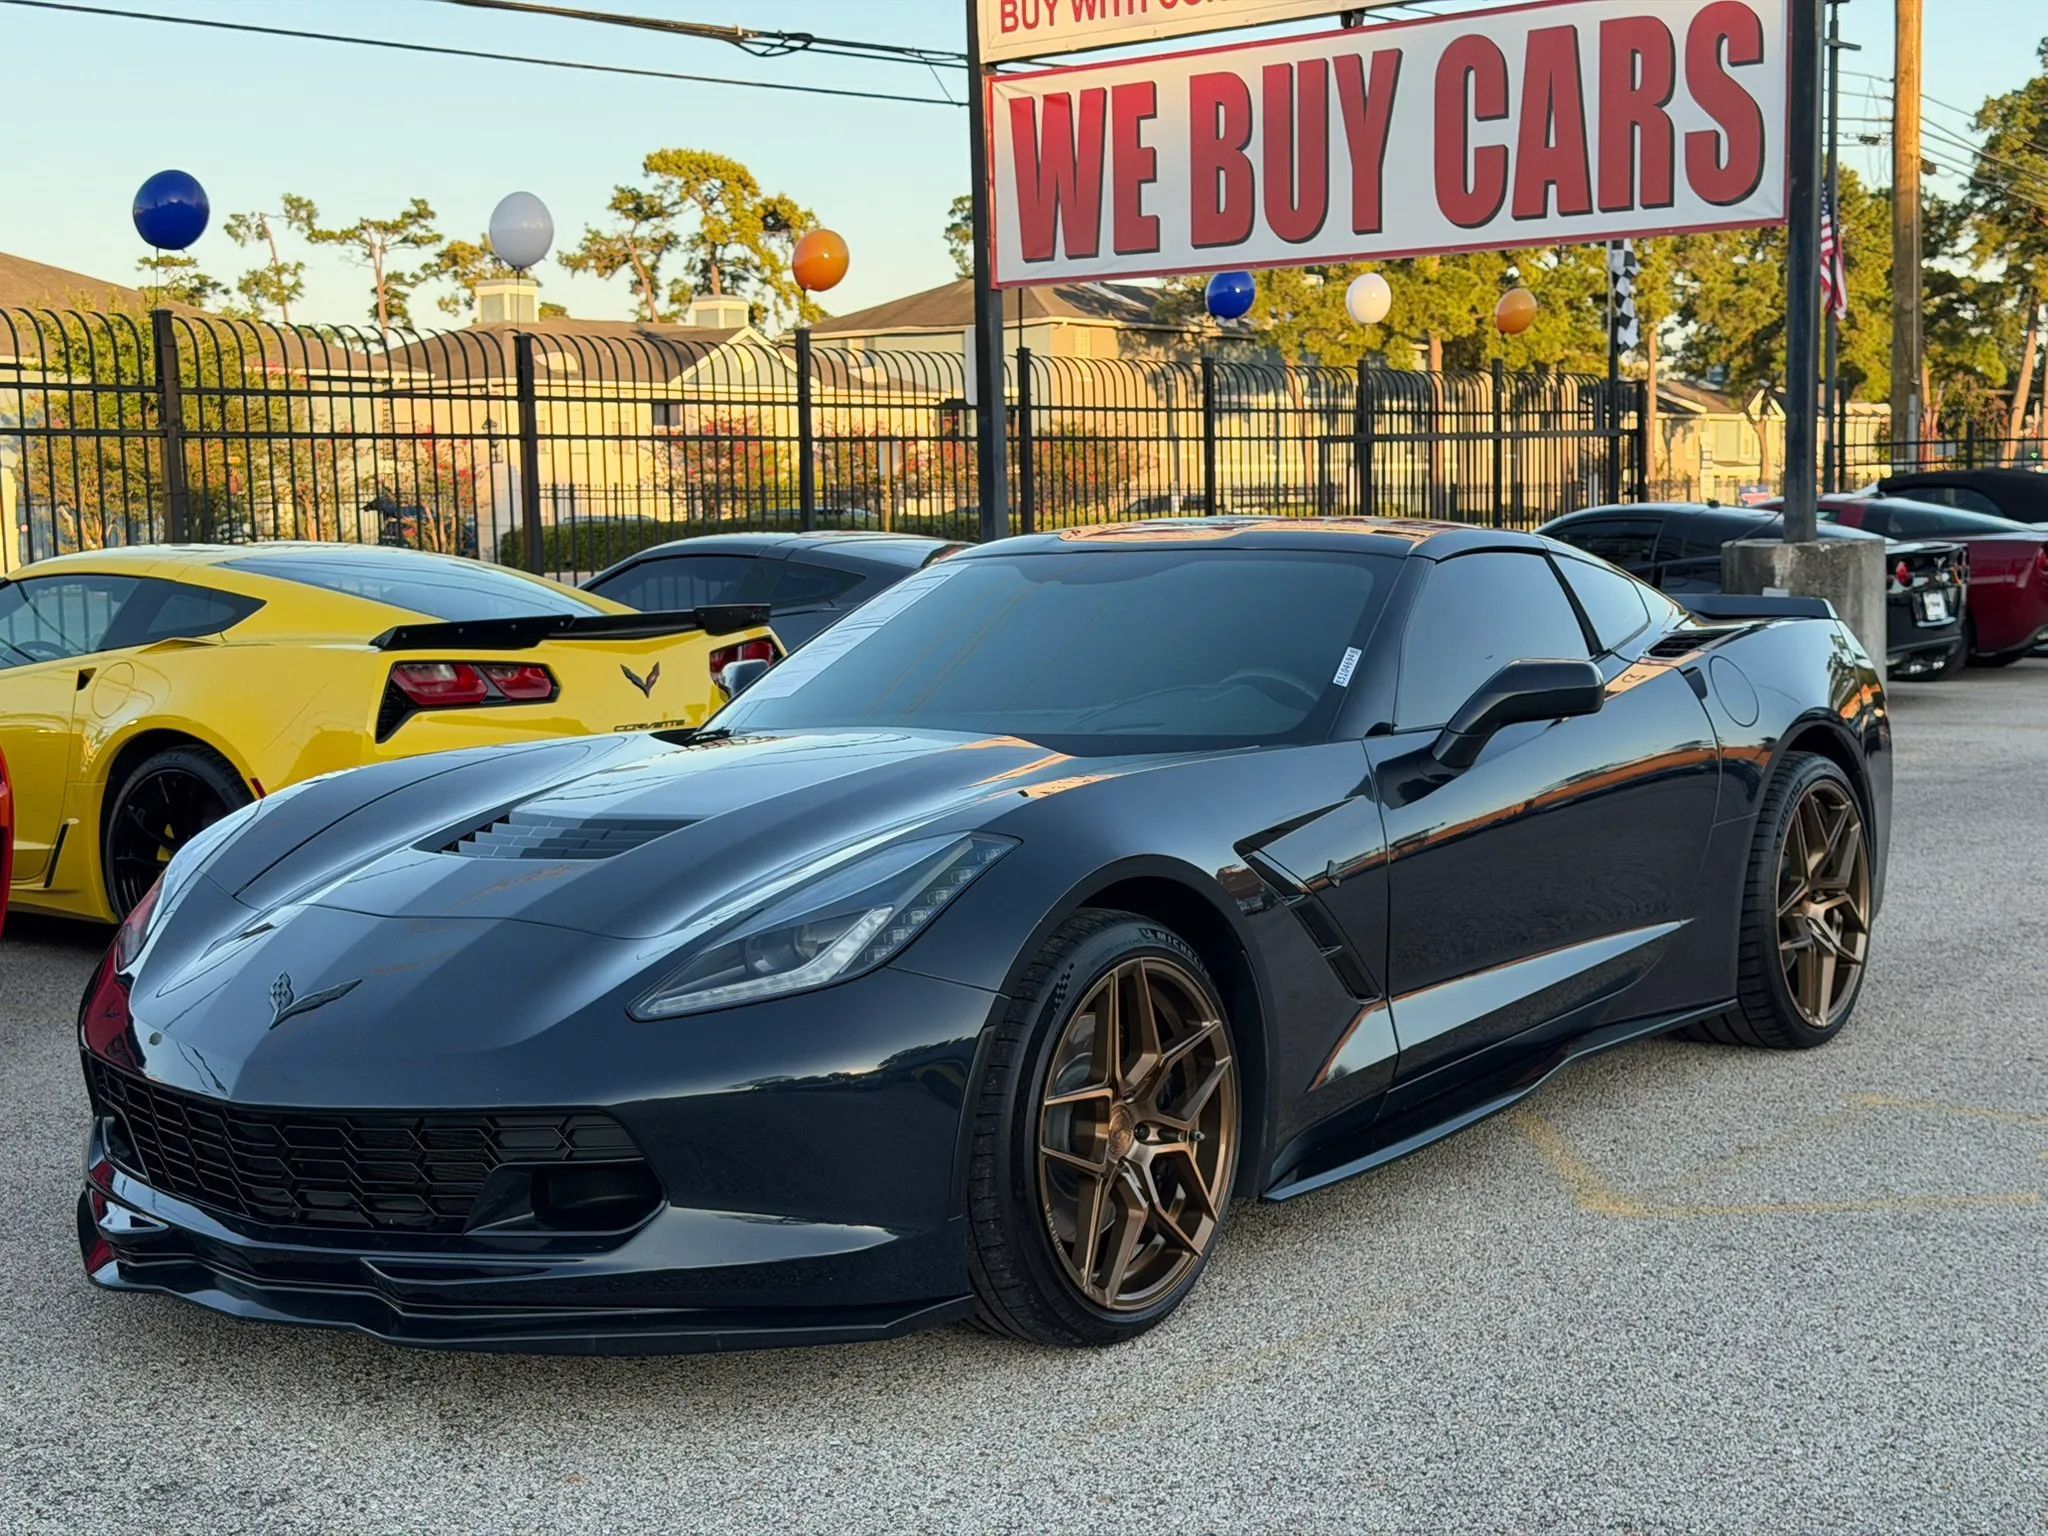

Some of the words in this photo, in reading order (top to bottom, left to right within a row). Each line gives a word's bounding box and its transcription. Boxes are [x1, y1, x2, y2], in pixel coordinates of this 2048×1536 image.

[1000, 0, 1058, 34] BUY
[1008, 80, 1160, 263] WE
[1189, 48, 1403, 249] BUY
[1434, 0, 1765, 229] CARS
